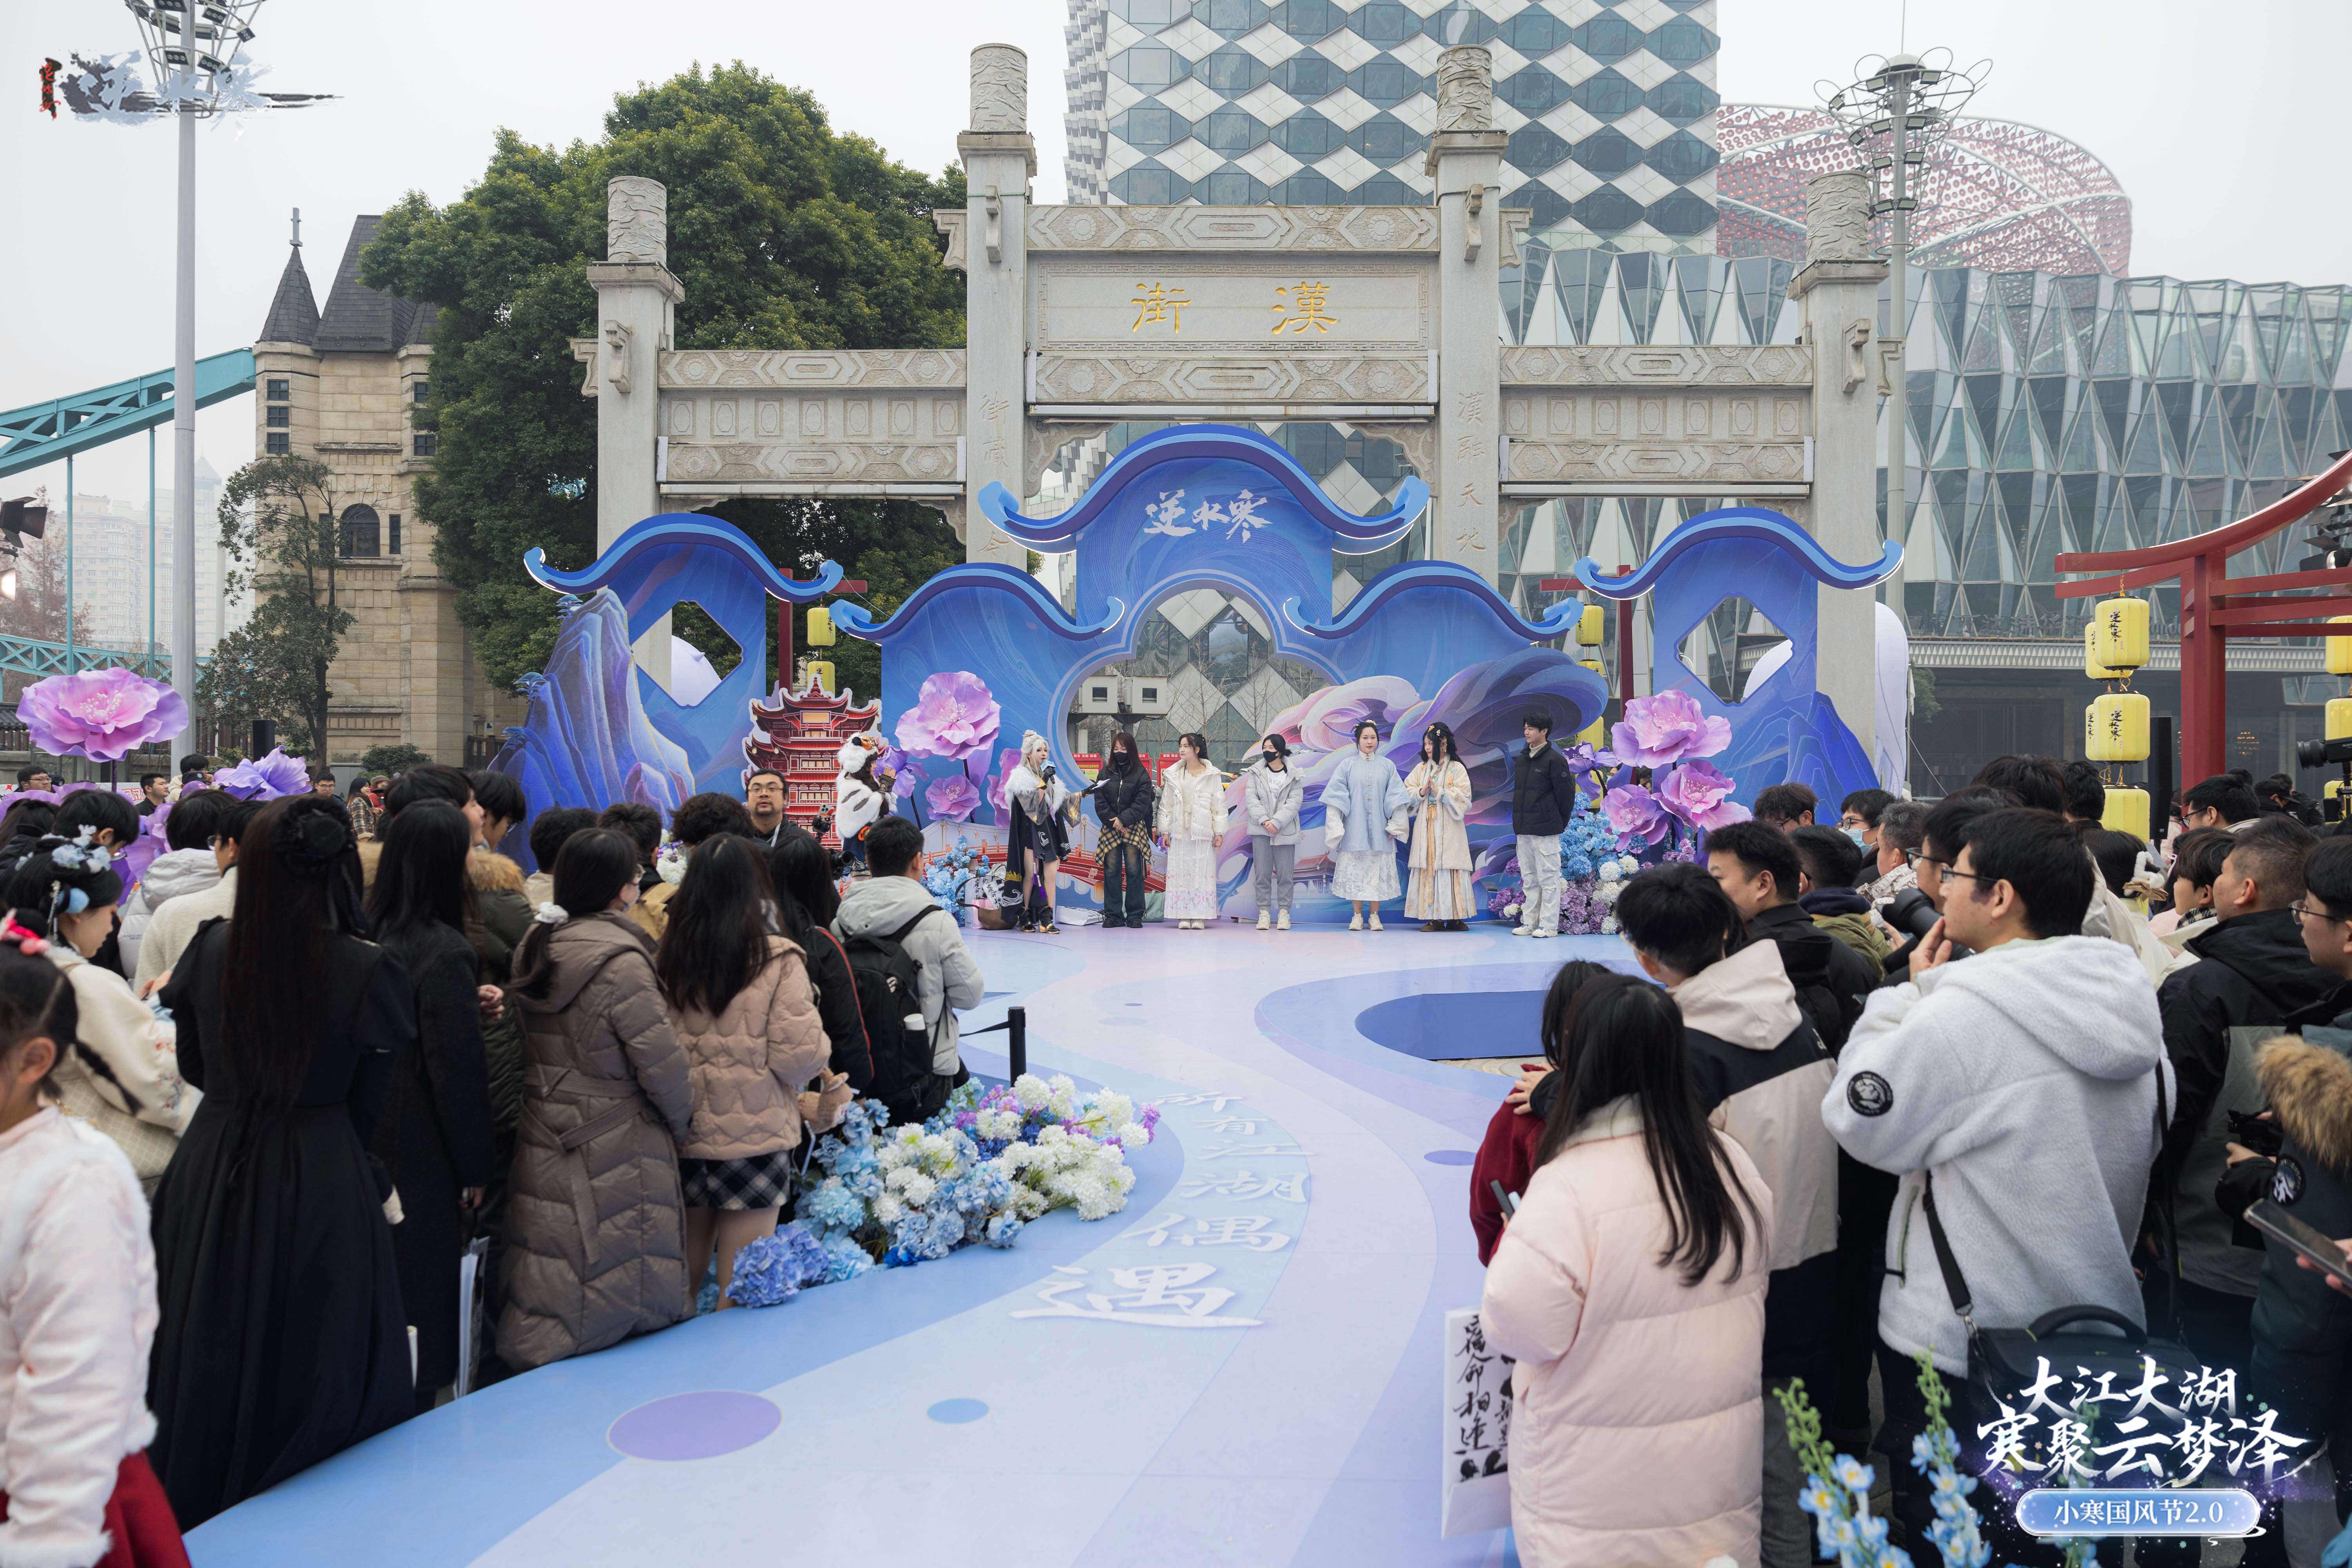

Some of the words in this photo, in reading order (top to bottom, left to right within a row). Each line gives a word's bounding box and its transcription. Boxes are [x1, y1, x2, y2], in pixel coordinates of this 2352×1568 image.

[978, 391, 1010, 557] 街藏今
[1143, 489, 1273, 543] 逆水寒
[1456, 391, 1487, 577] 漢融天地
